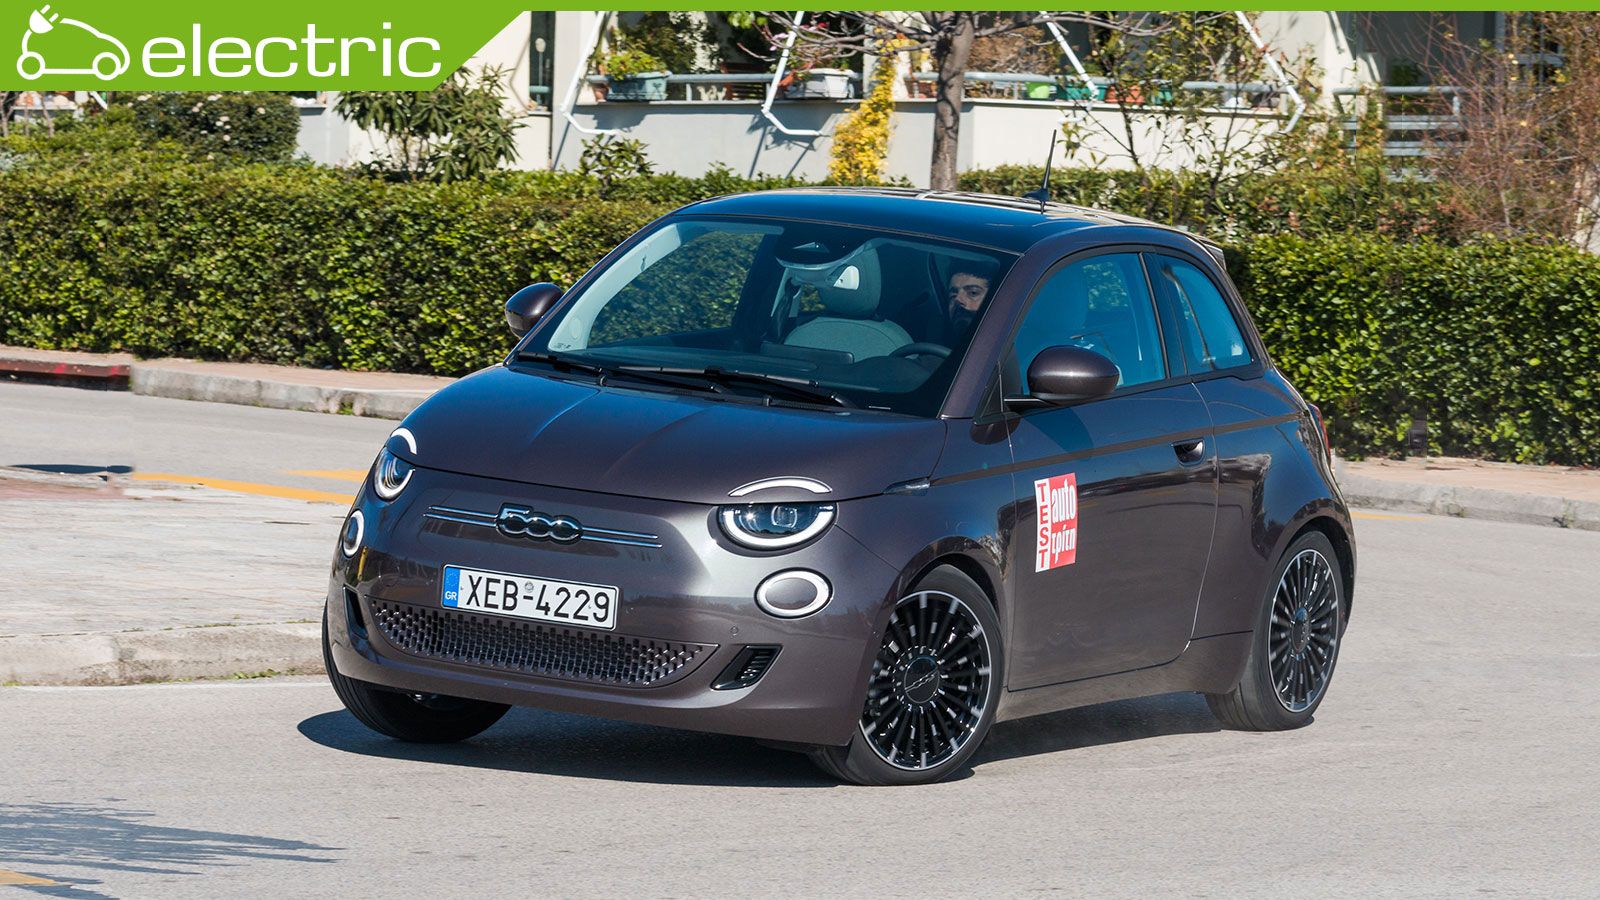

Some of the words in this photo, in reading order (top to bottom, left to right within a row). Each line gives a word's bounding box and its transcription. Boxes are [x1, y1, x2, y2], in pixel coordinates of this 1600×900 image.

[1051, 478, 1076, 523] auto
[496, 503, 583, 545] 500
[1037, 482, 1049, 568] TEST
[445, 590, 457, 601] GR
[466, 574, 610, 623] XEB-4229
